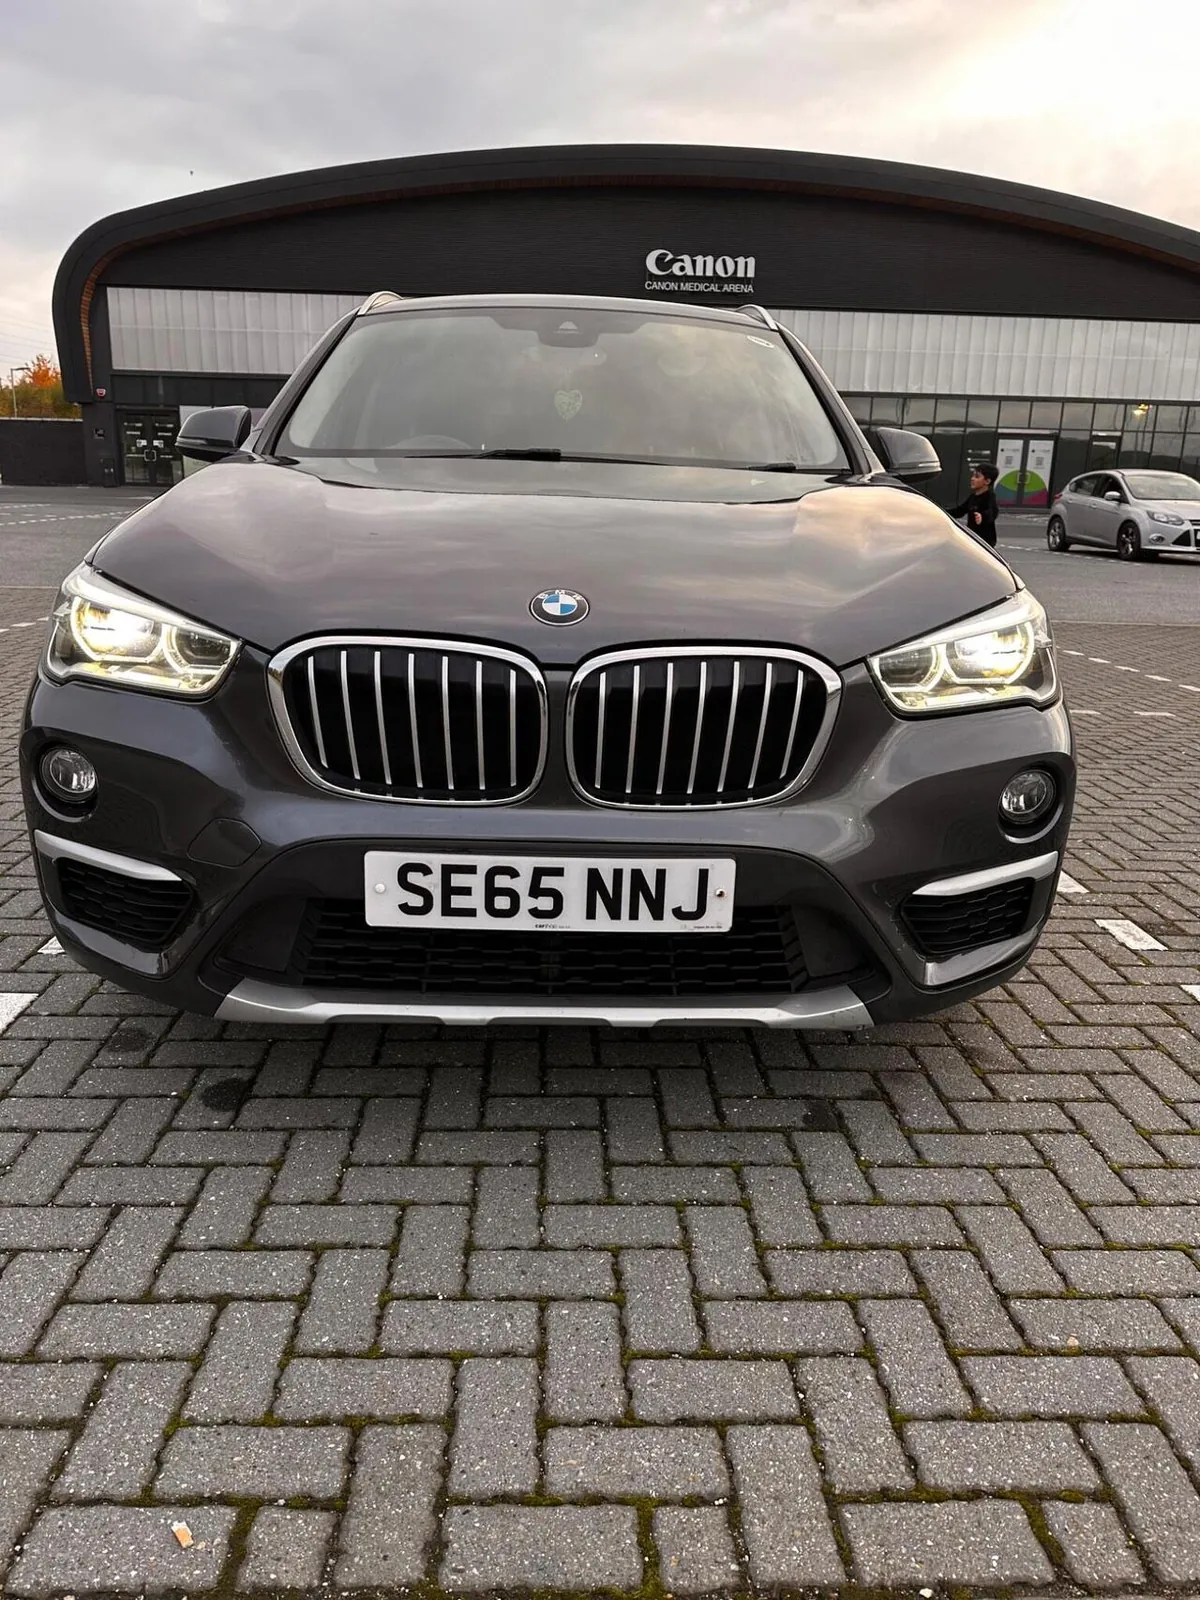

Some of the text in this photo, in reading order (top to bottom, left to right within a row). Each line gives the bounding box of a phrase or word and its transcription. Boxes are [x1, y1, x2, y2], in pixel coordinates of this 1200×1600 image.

[646, 249, 755, 278] Canon
[645, 281, 753, 293] CANON MEDICAL ARENA
[397, 862, 710, 921] SE65 NNJ
